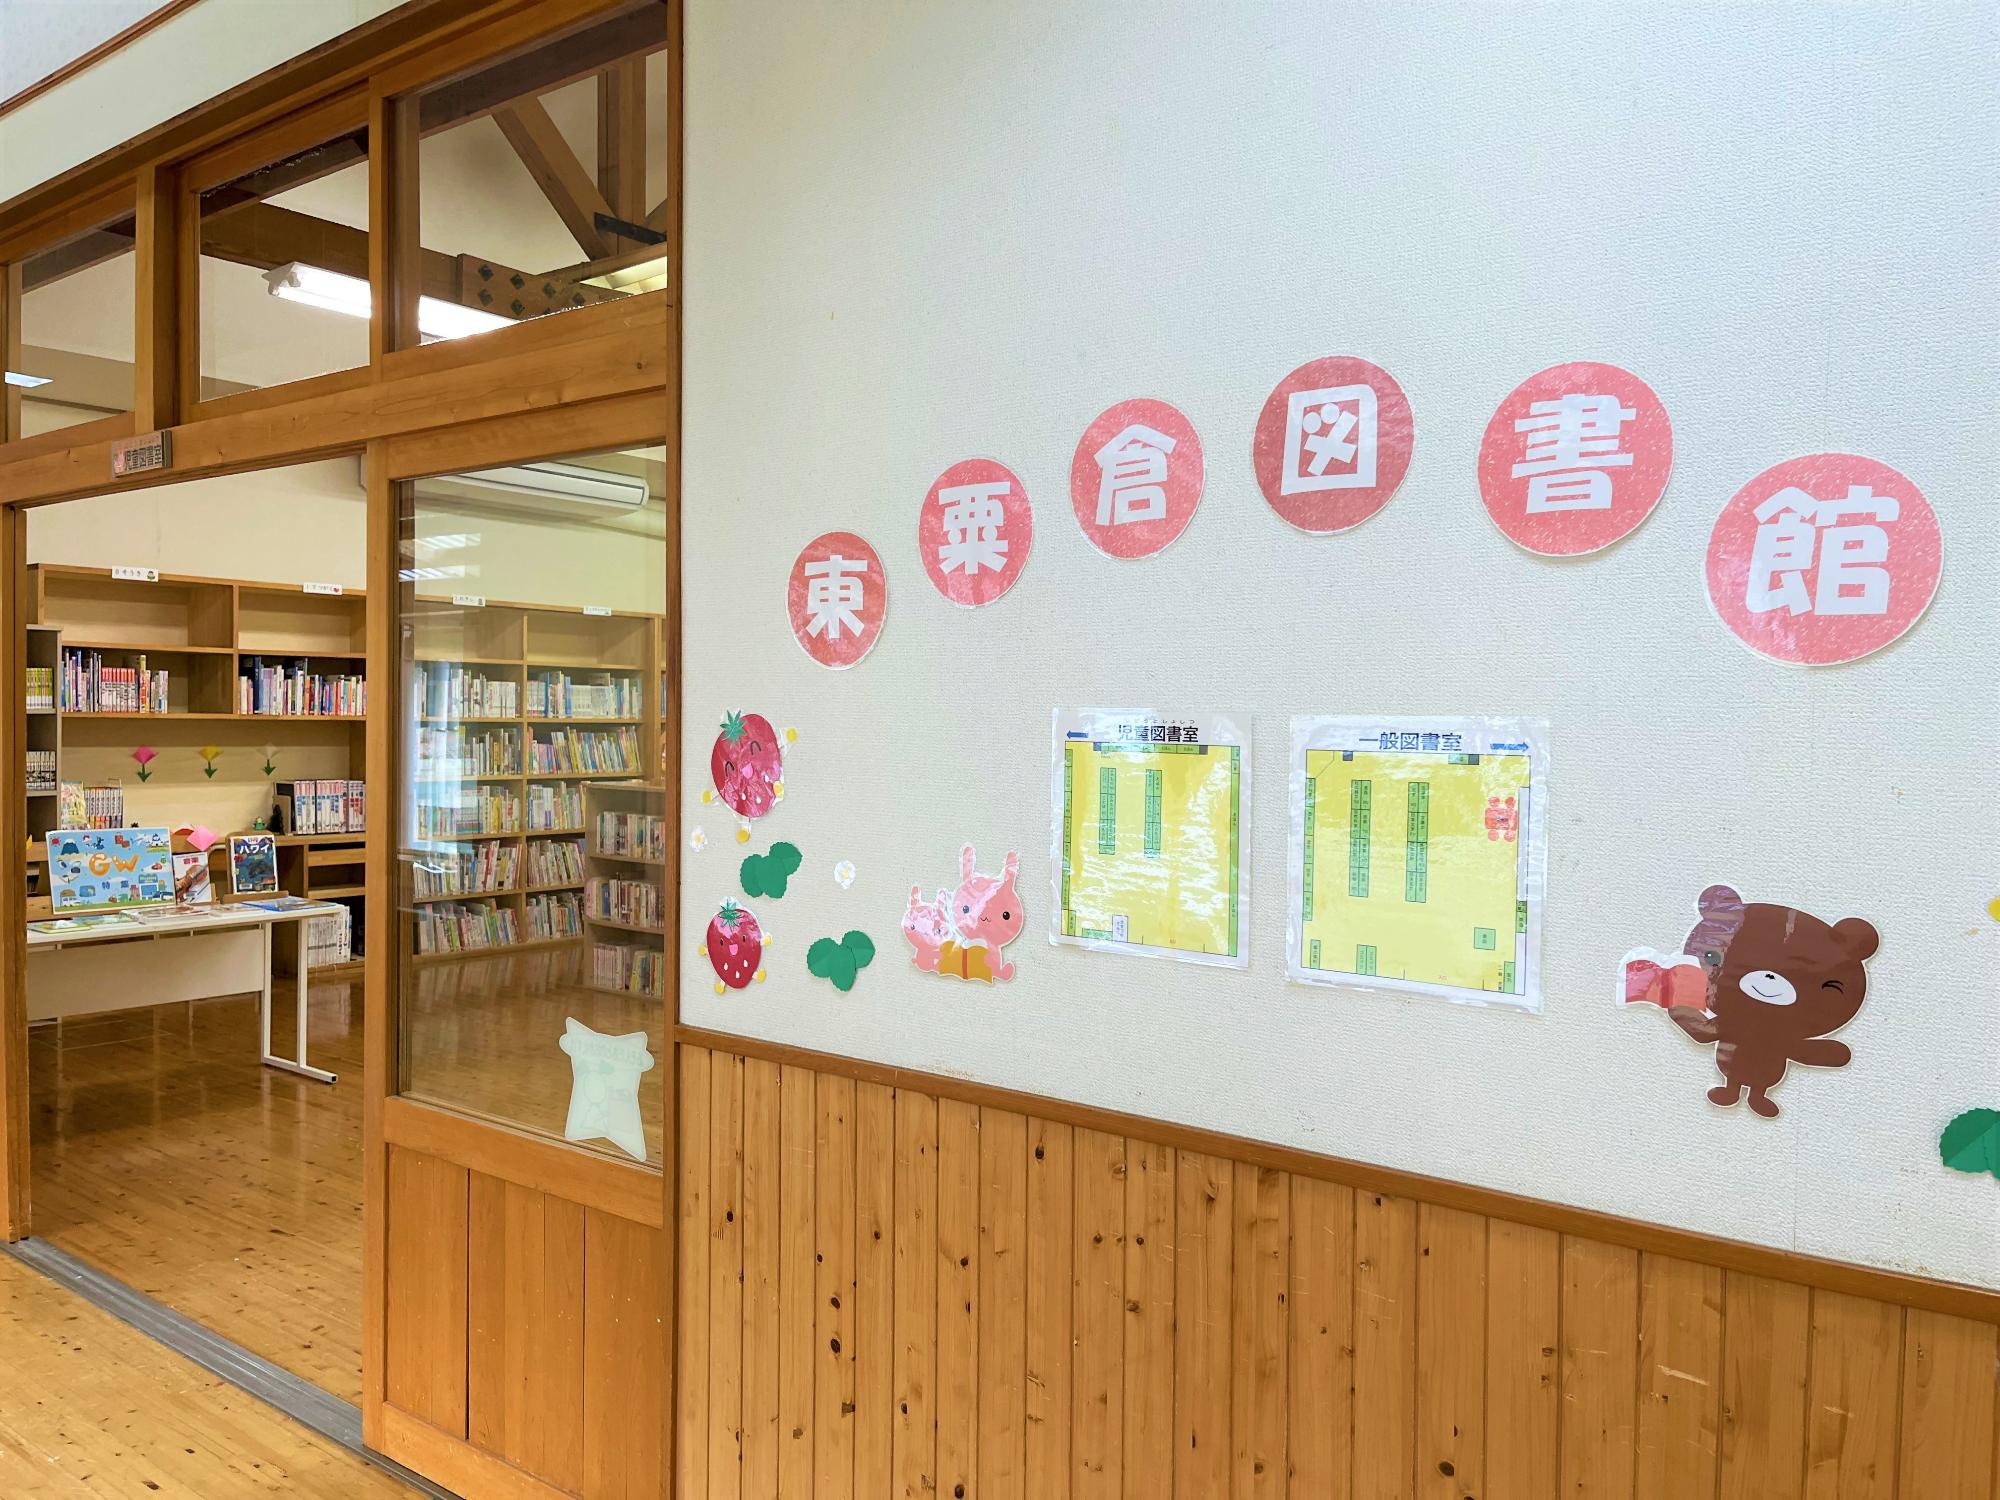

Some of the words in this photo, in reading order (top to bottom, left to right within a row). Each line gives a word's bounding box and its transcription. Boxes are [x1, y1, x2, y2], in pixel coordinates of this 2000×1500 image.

[1118, 724, 1199, 743] 児童図書室
[1358, 731, 1462, 751] 一般図書室
[239, 844, 269, 854] ハワイ
[89, 852, 139, 877] GW
